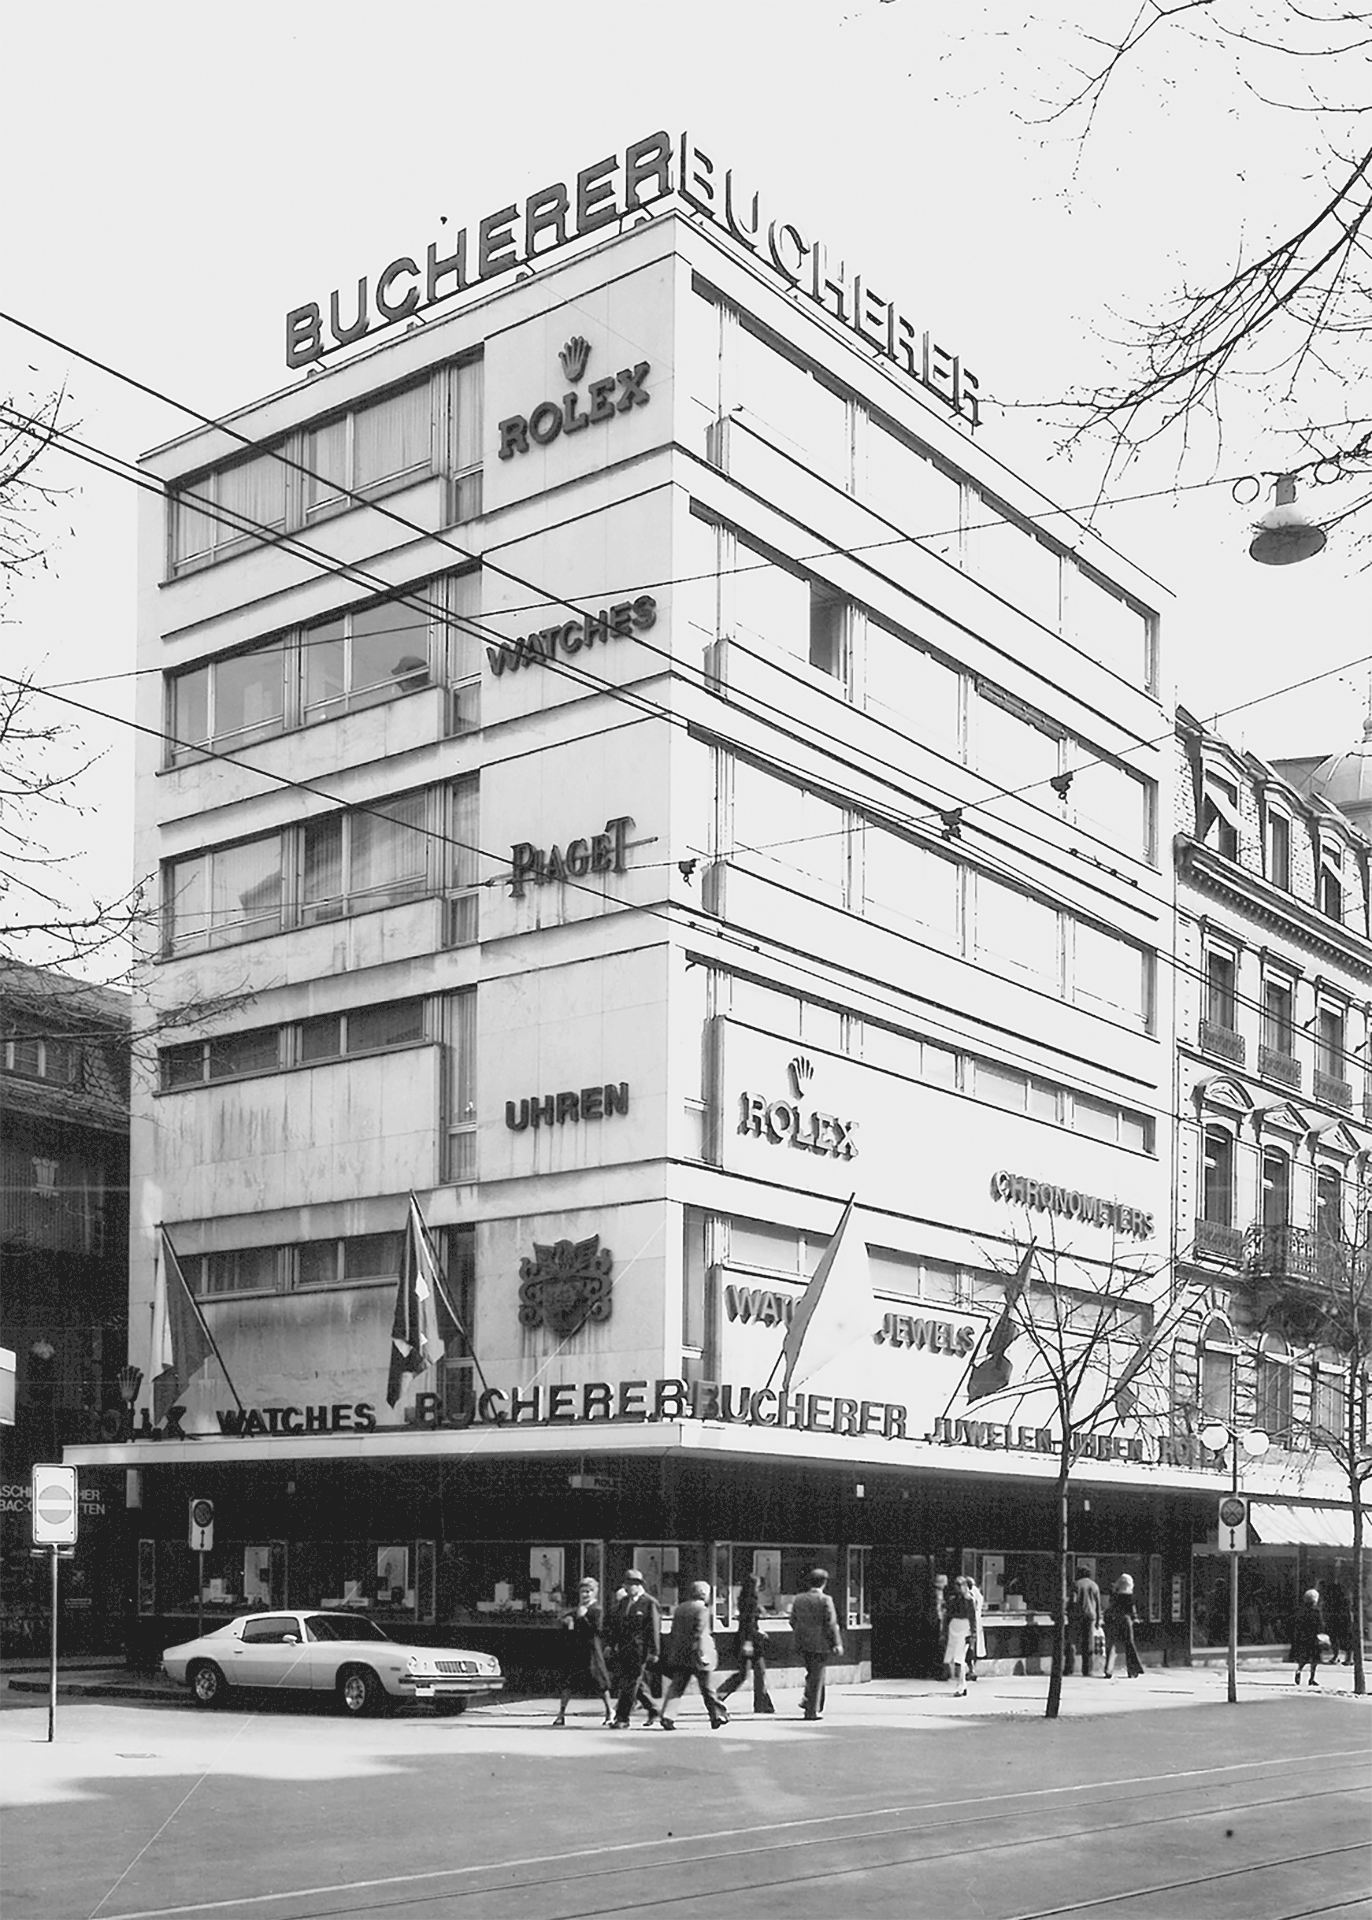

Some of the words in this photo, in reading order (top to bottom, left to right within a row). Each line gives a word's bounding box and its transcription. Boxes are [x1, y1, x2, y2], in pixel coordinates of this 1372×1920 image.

[286, 130, 674, 369] BUCHERER
[677, 131, 983, 427] BUCHERER
[498, 360, 651, 460] ROLEX
[486, 595, 657, 676] WATCHES
[508, 815, 637, 898] PIAGET
[505, 1081, 629, 1132] UHREN
[737, 1091, 860, 1162] ROLEX
[990, 1169, 1156, 1241] CHRONOMETERS
[873, 1312, 976, 1358] JEWELS
[216, 1402, 377, 1439] WATCHES
[415, 1378, 690, 1429] BUCHERER
[692, 1379, 908, 1439] BUCHERER
